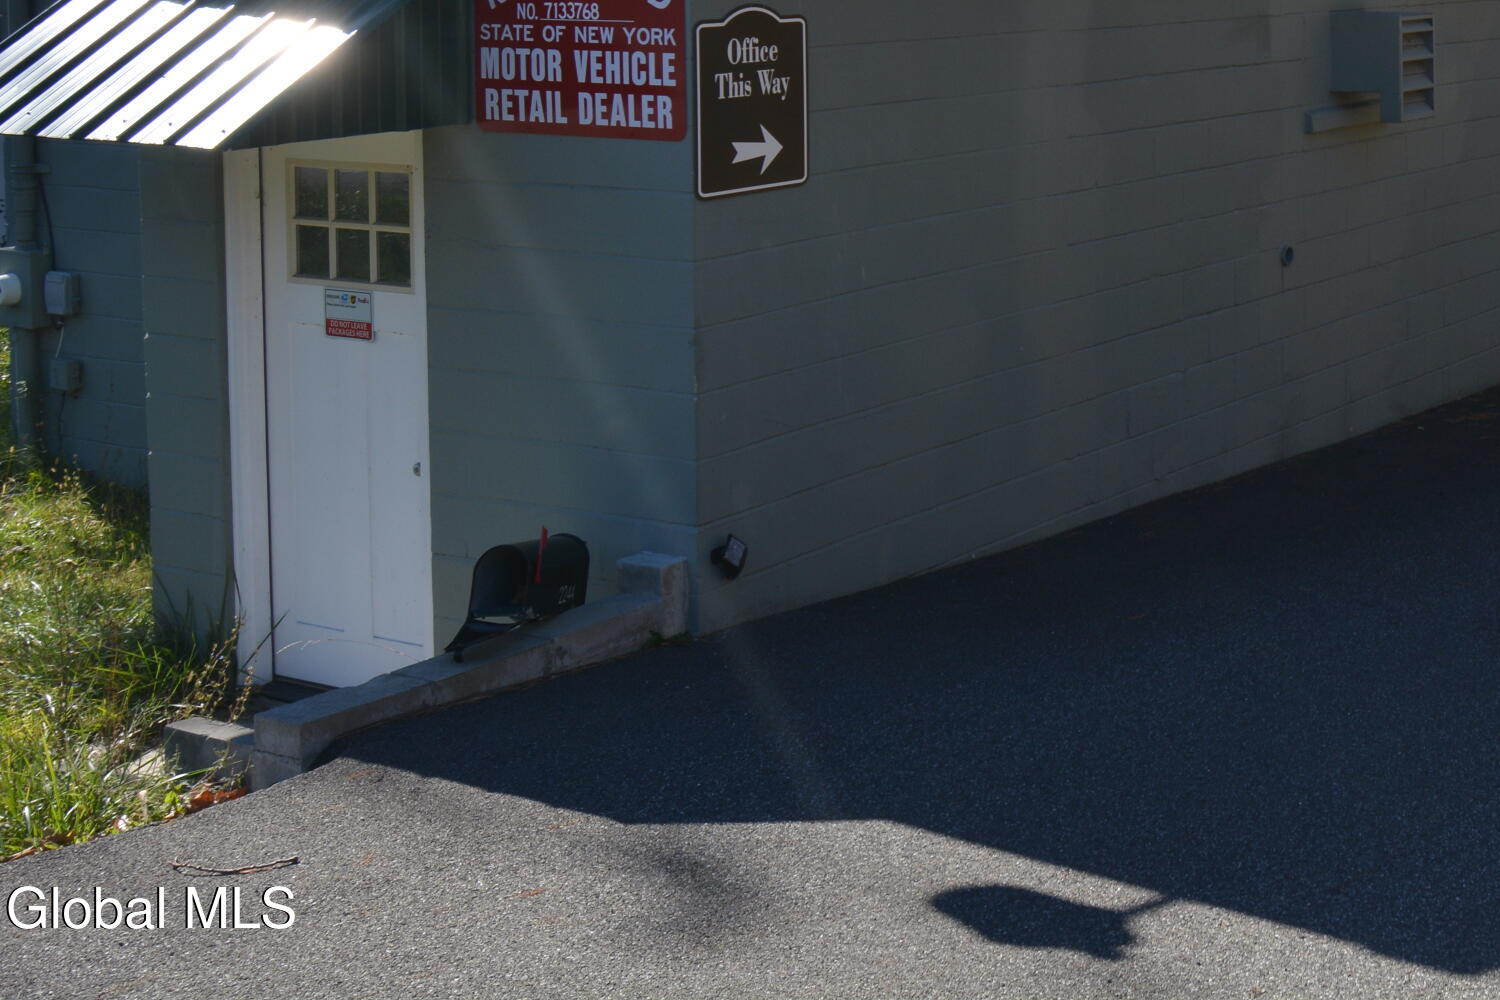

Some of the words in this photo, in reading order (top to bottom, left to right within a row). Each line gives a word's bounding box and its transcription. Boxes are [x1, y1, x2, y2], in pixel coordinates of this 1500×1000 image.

[516, 2, 539, 20] NO.
[543, 2, 600, 20] 7133768
[480, 23, 534, 42] STATE
[542, 25, 566, 42] OF
[574, 26, 614, 44] NEW
[622, 27, 676, 46] YORK
[727, 37, 778, 65] Office
[480, 47, 562, 82] MOTOR
[573, 49, 677, 87] VEHICLE
[714, 72, 752, 100] This
[756, 68, 790, 101] Way
[485, 87, 568, 124] RETAIL
[578, 91, 673, 130] DEALER
[328, 327, 355, 336] PACKAGES
[356, 330, 370, 338] HERE
[351, 322, 368, 330] LEAVE
[557, 584, 576, 604] 2244
